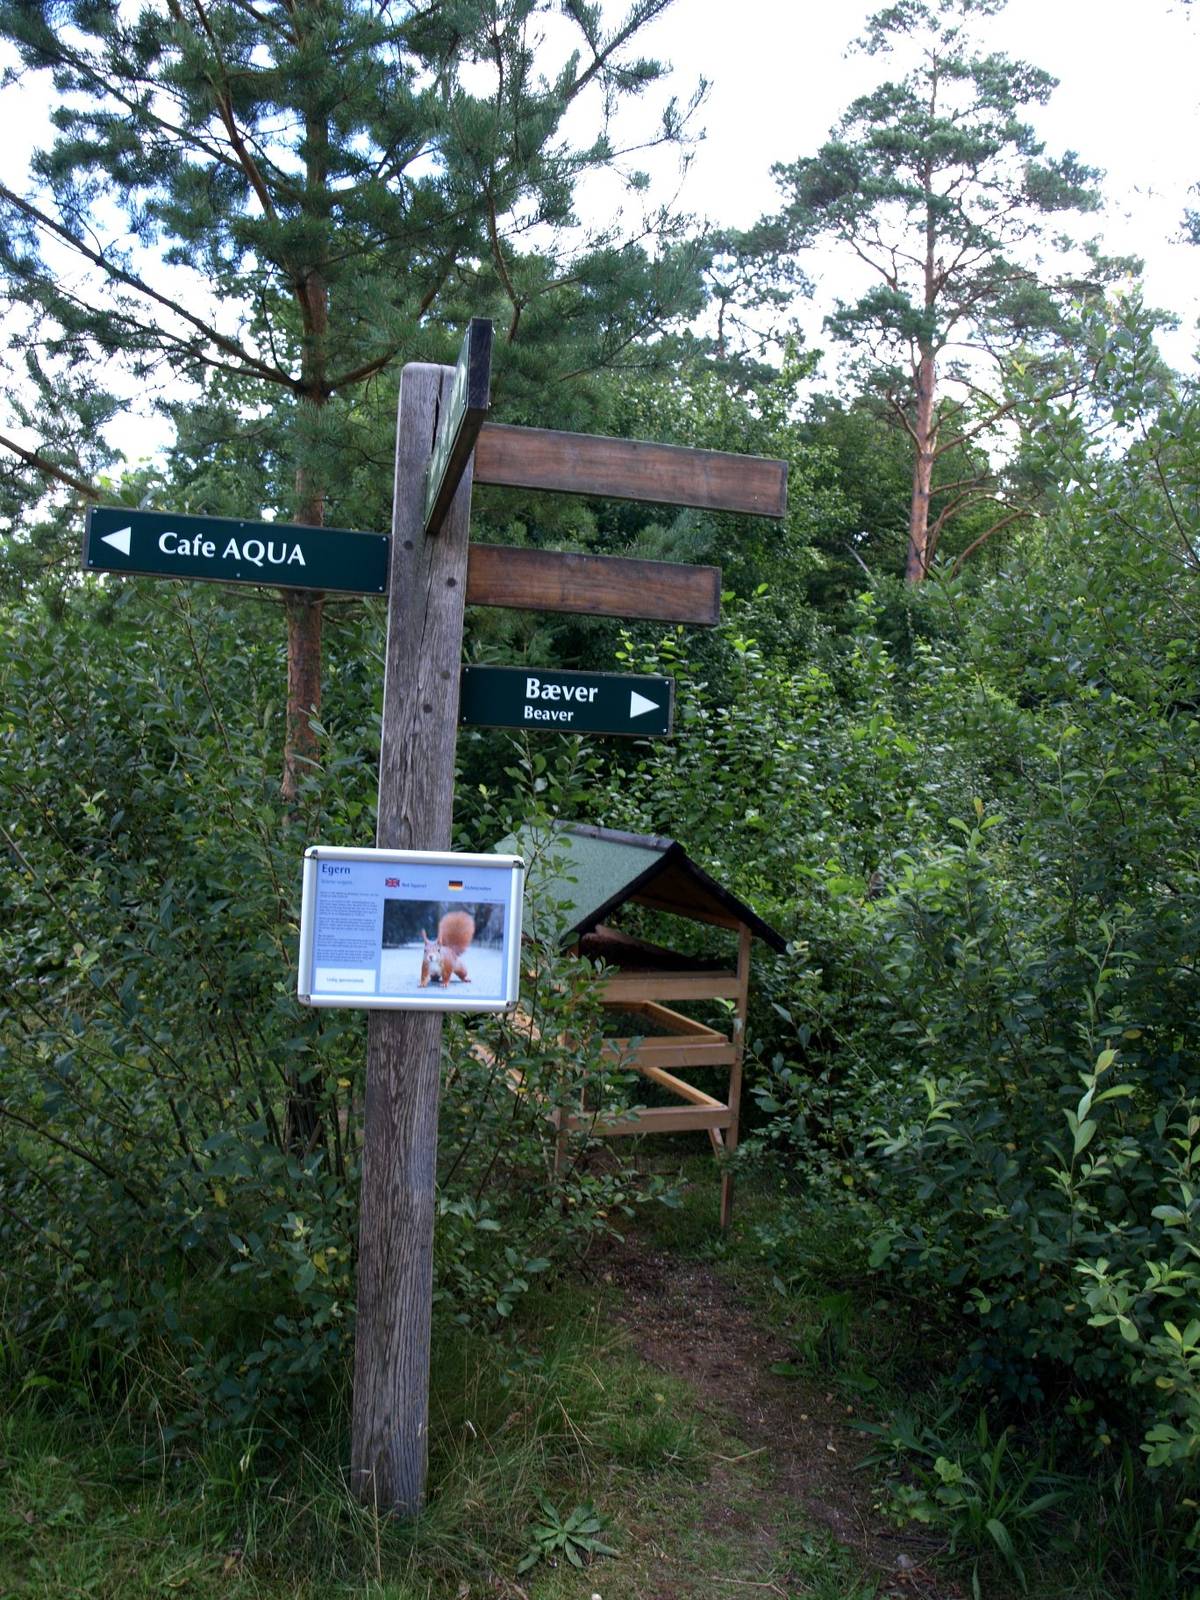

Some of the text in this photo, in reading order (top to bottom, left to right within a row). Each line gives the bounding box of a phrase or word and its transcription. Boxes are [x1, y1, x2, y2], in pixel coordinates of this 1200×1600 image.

[158, 532, 306, 567] Cafe AQUA
[525, 677, 598, 702] Bæver
[524, 705, 574, 721] Beaver
[322, 863, 350, 876] Egern
